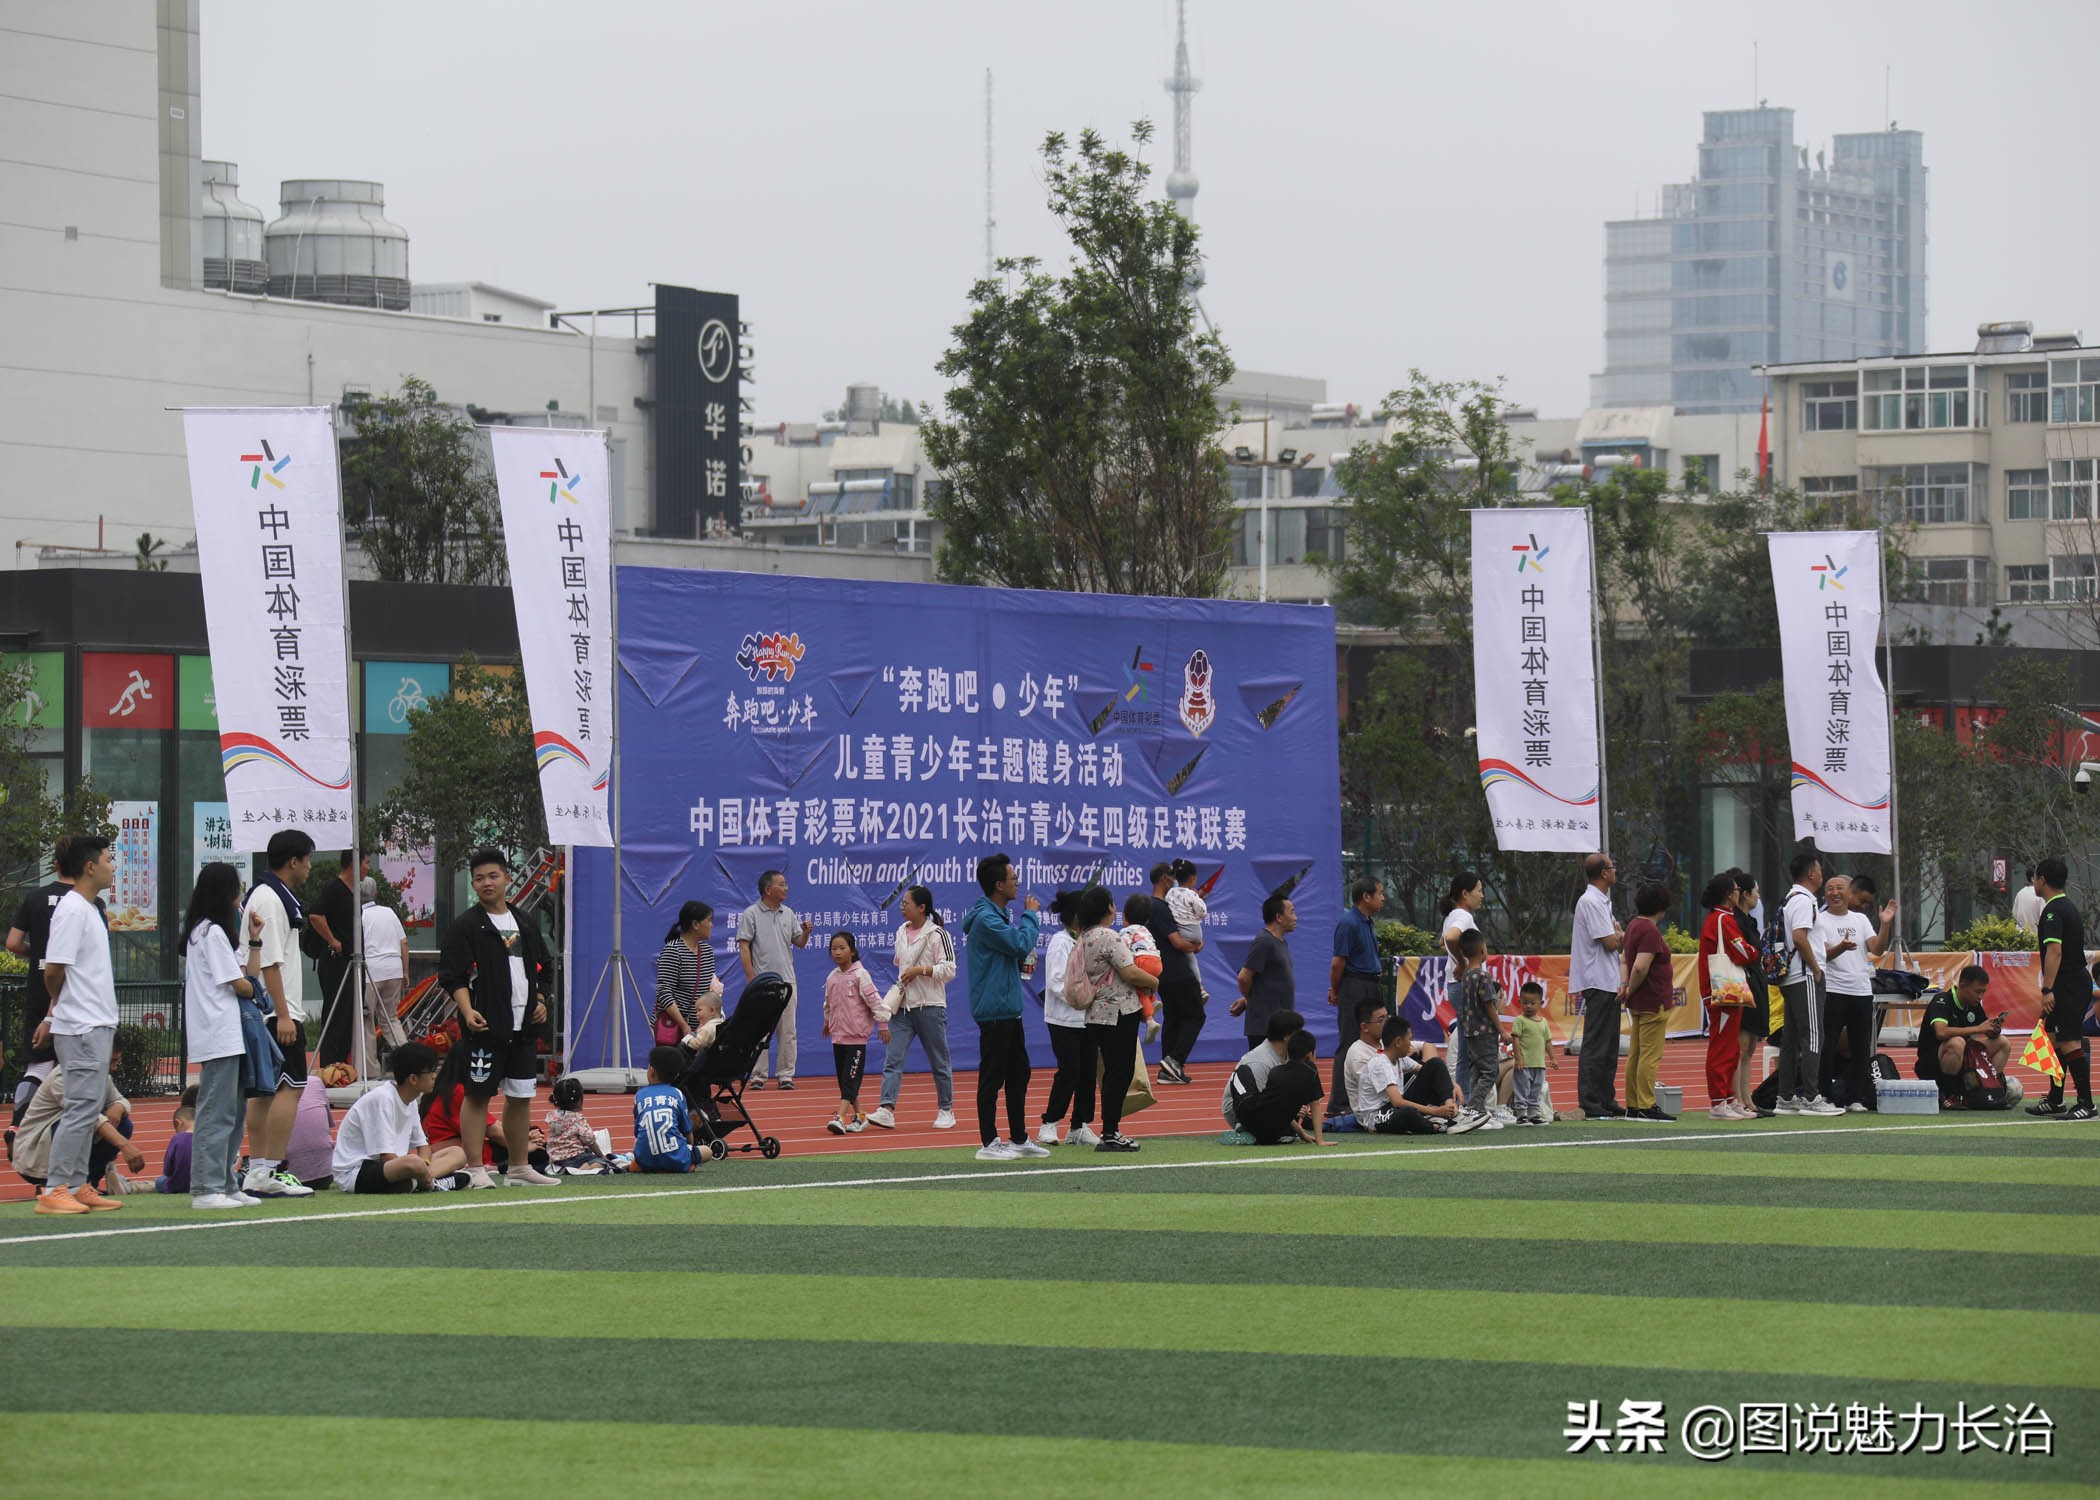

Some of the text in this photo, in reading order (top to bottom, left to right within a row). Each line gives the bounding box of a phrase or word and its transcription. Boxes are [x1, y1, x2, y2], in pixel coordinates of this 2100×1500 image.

[833, 733, 1123, 787] 儿童青少年主题健身活动
[690, 797, 1247, 850] 中国体育彩票杯2021长治市青少年四级足球联赛
[807, 856, 873, 885] Children
[876, 855, 909, 883] and
[912, 856, 962, 886] youth
[640, 1108, 679, 1155] 12
